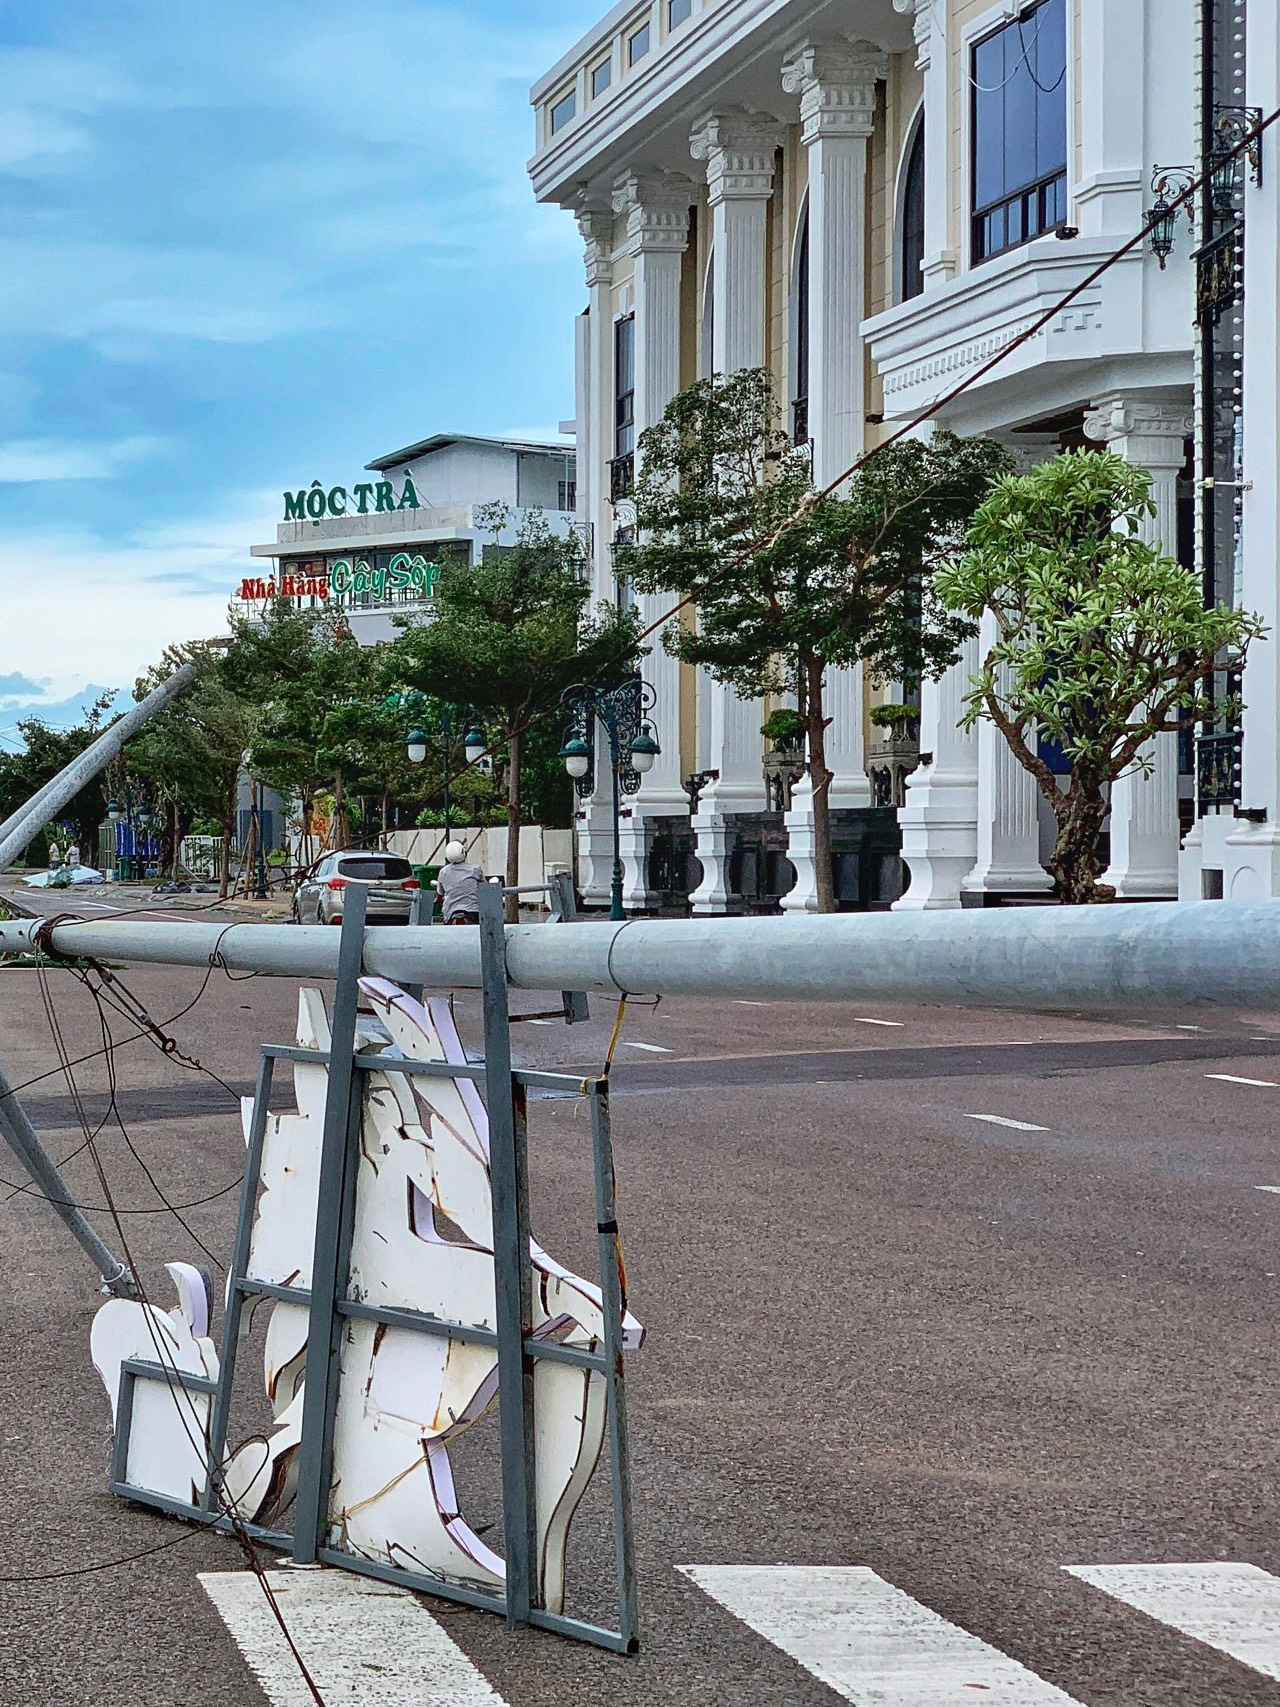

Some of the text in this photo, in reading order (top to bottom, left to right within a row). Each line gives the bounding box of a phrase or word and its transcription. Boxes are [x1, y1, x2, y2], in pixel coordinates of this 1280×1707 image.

[283, 469, 421, 526] MỘC TRÀ
[241, 573, 277, 600] Nhà
[281, 571, 330, 601] Hàng
[332, 560, 386, 600] Cây
